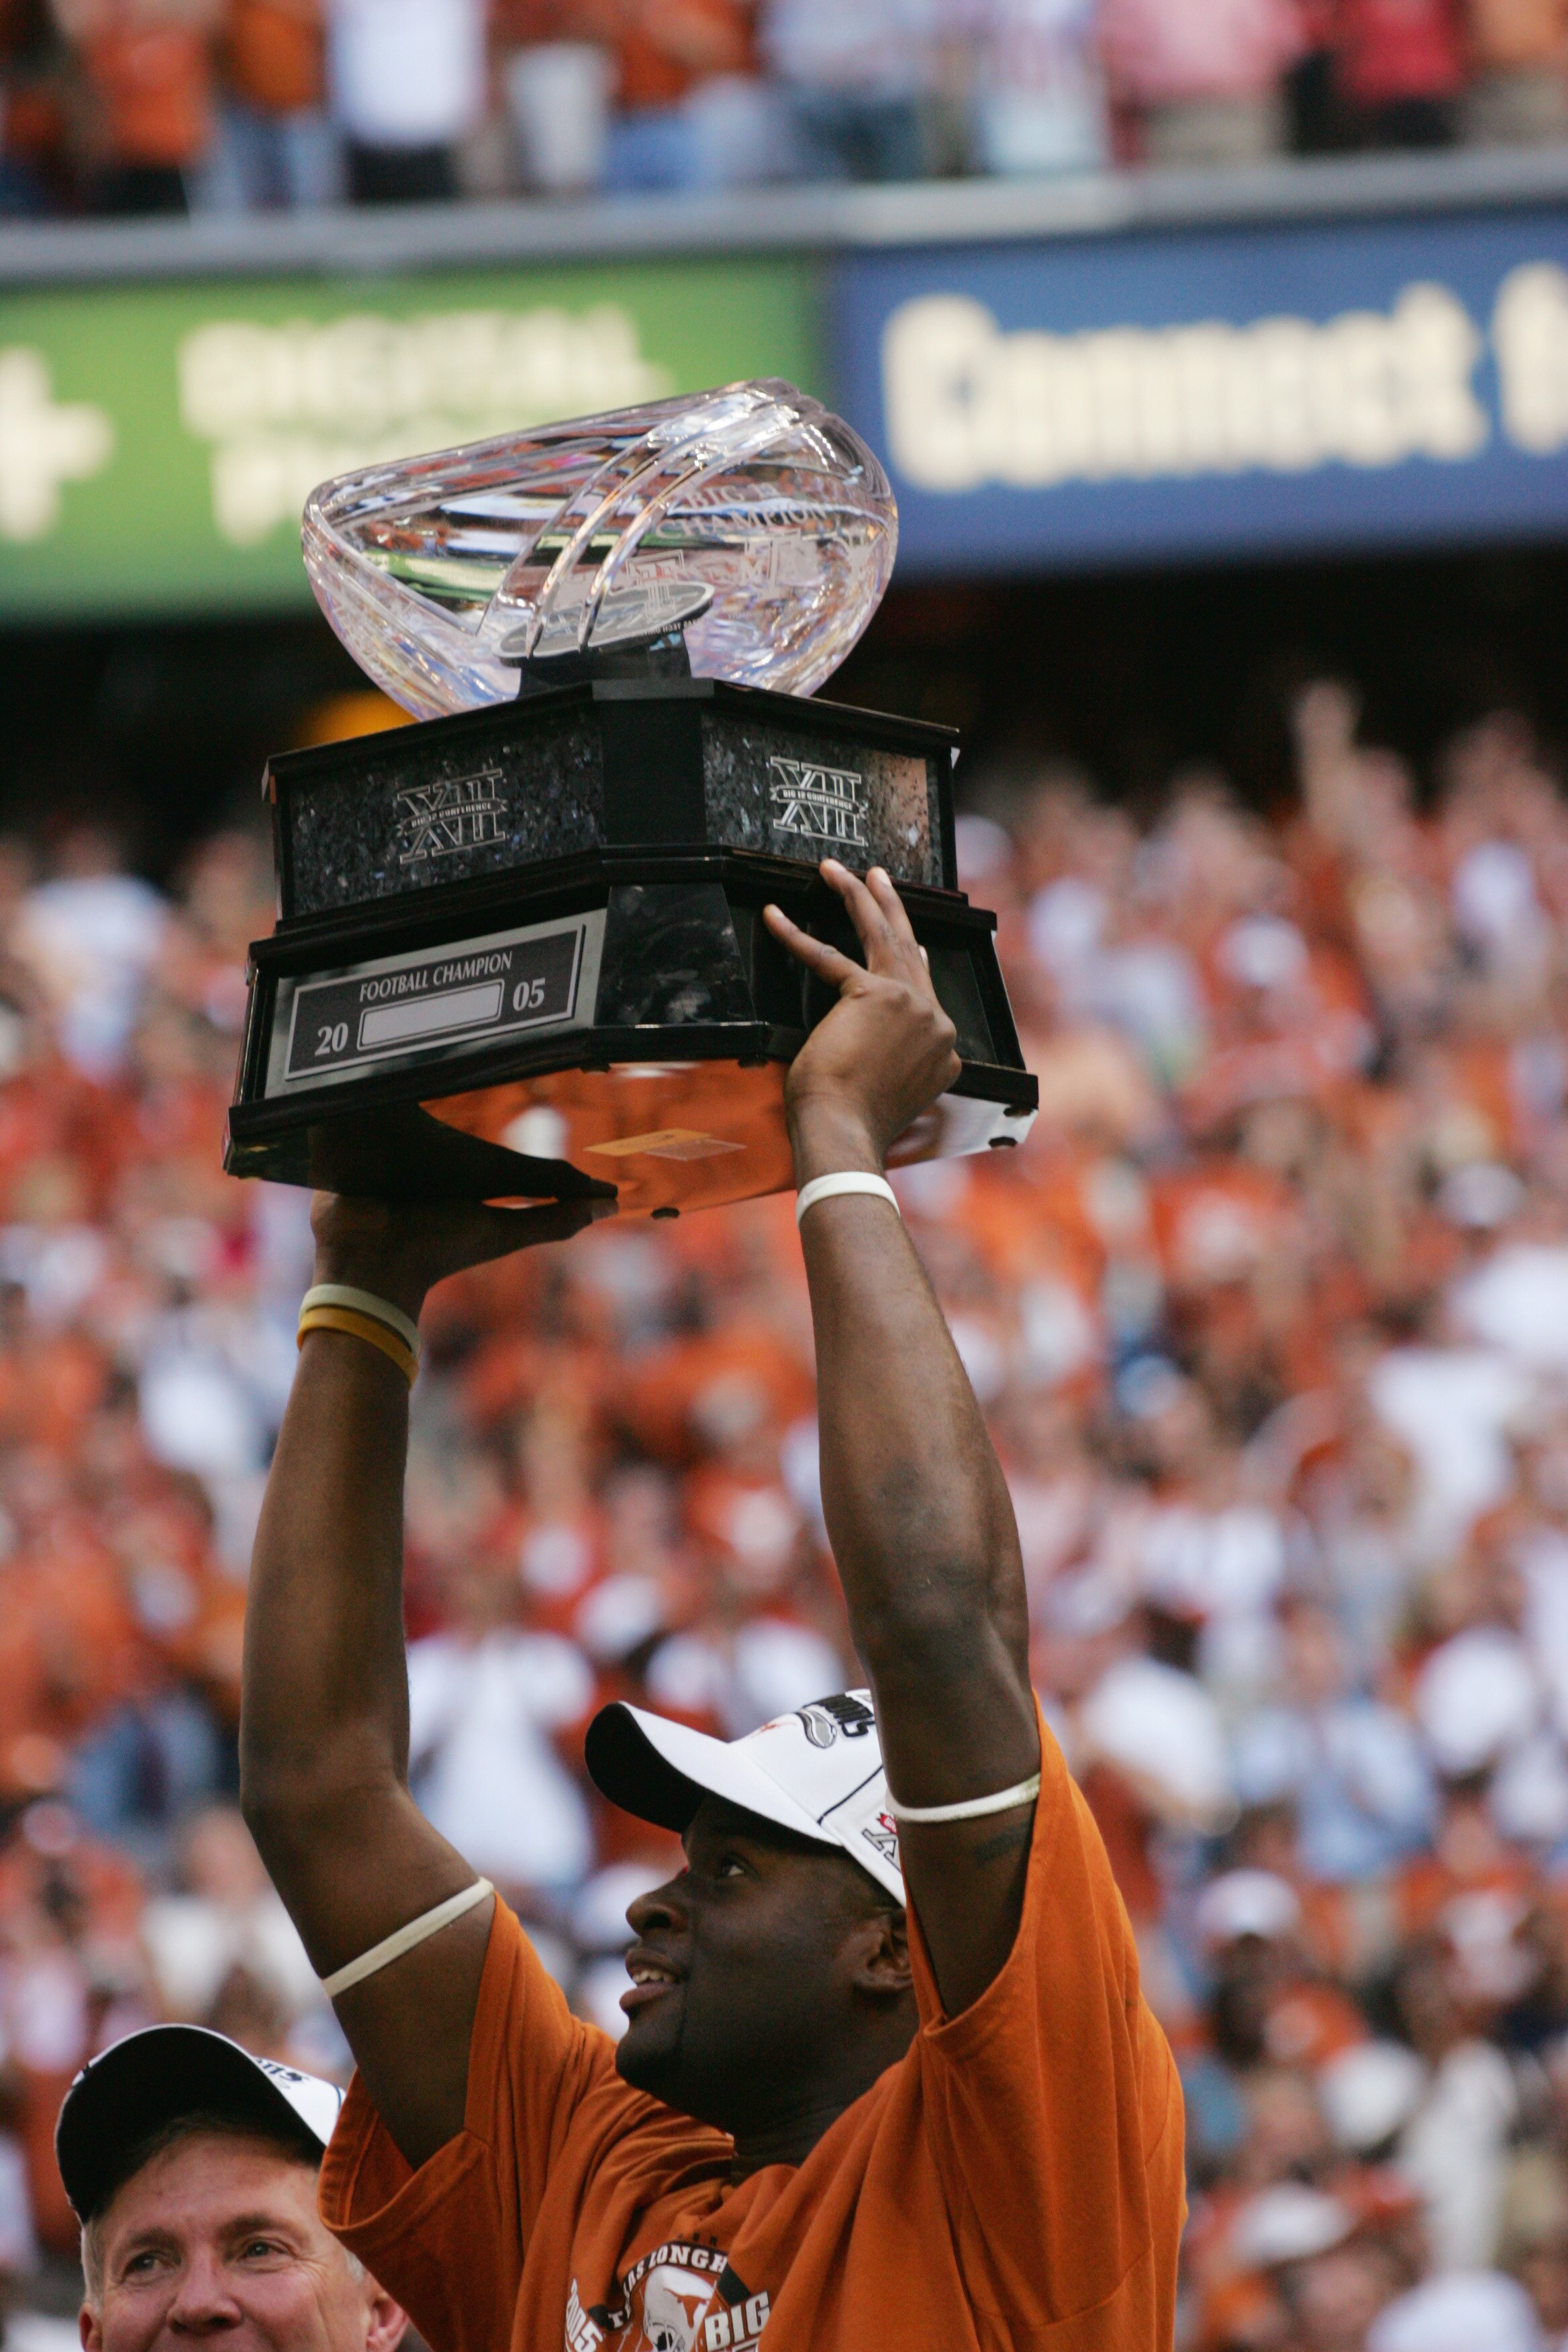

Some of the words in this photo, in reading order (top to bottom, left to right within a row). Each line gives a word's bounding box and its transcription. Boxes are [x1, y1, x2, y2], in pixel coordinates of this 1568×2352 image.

[358, 970, 429, 1003] FOOTBALL
[432, 950, 513, 985] CHAMPION
[314, 1022, 349, 1057] 20
[512, 977, 546, 1012] 05
[704, 2290, 771, 2351] BIG
